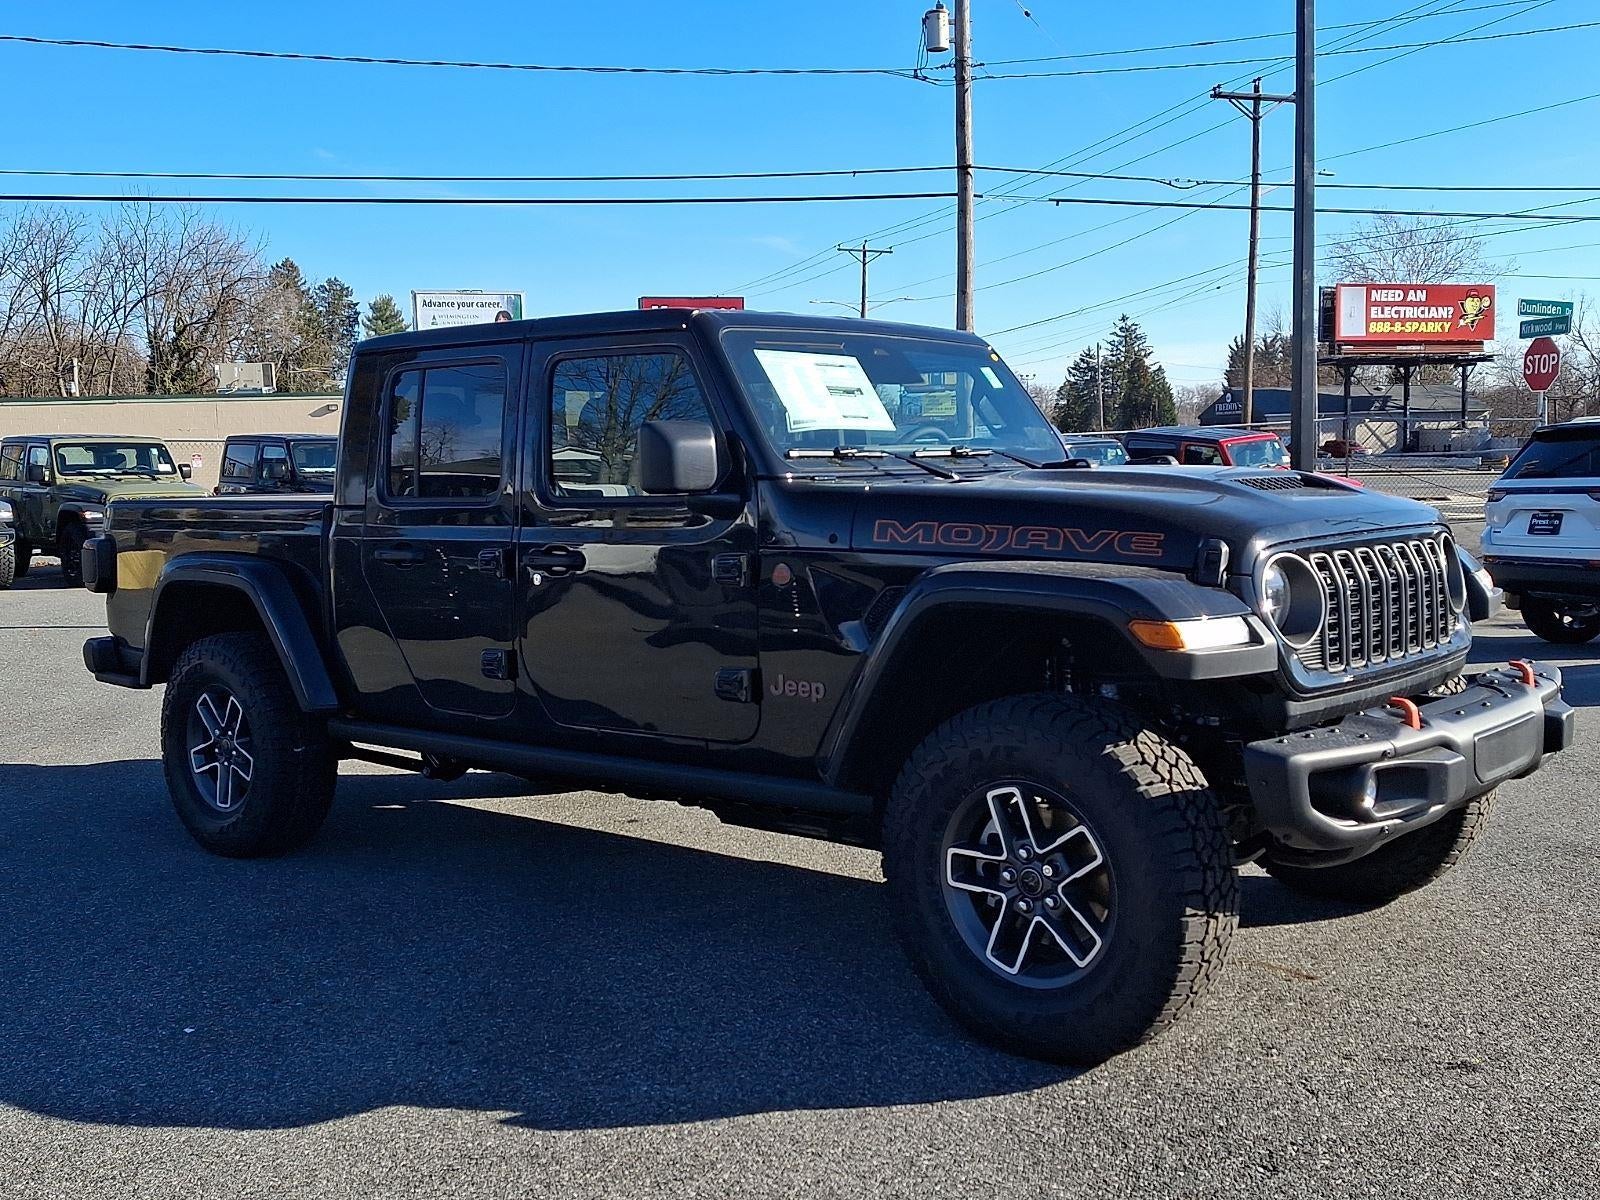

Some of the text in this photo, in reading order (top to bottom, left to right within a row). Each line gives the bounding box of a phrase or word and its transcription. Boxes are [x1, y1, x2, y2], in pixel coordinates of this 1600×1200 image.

[1370, 289, 1427, 302] NEED AN
[422, 299, 503, 310] Advance your career.
[1521, 302, 1573, 315] Dunlinden Dr
[1370, 306, 1454, 319] ELECTRICIAN?
[1369, 321, 1452, 333] 888-8-SPARKY
[1521, 321, 1567, 334] Kirkwood Hwy
[1525, 353, 1558, 375] STOP
[873, 520, 1165, 556] MOJAVE
[769, 674, 826, 702] Jeep
